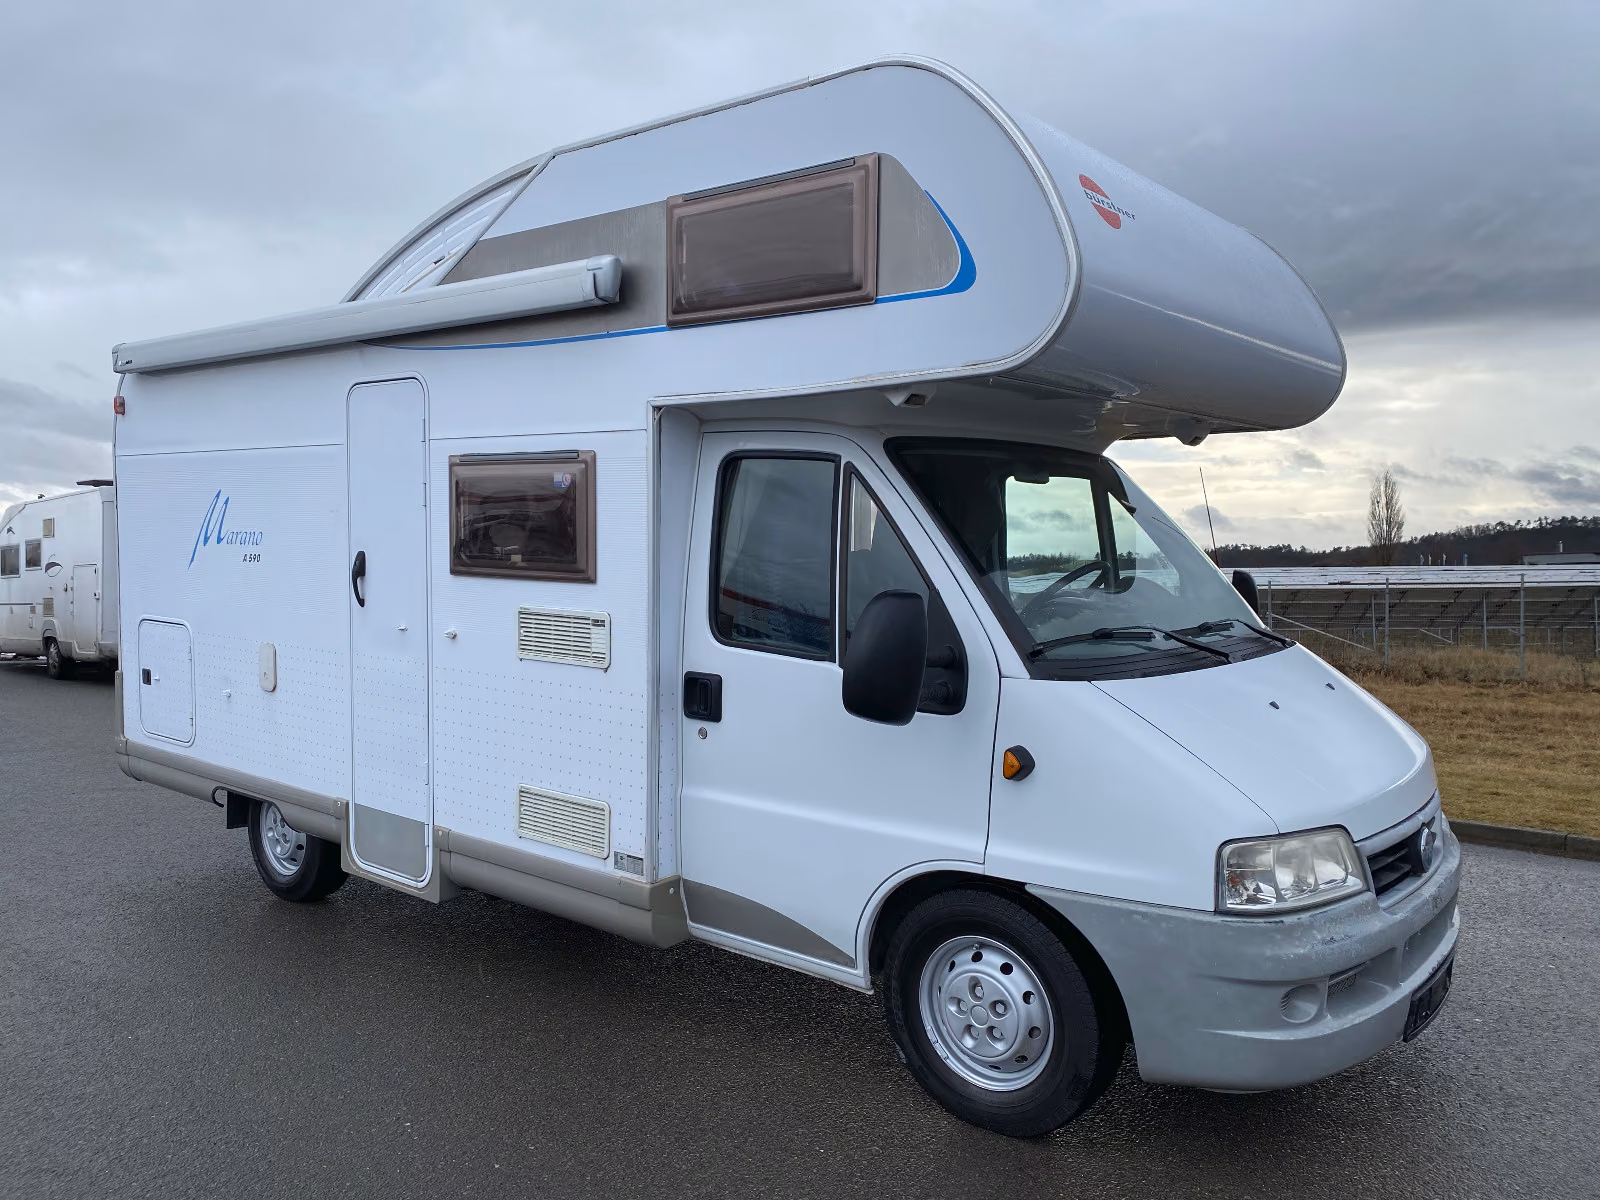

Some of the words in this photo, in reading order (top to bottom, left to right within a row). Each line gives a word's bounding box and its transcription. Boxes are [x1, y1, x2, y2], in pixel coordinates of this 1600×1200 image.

[187, 489, 263, 570] Marano
[242, 553, 248, 563] A
[248, 553, 261, 563] 590
